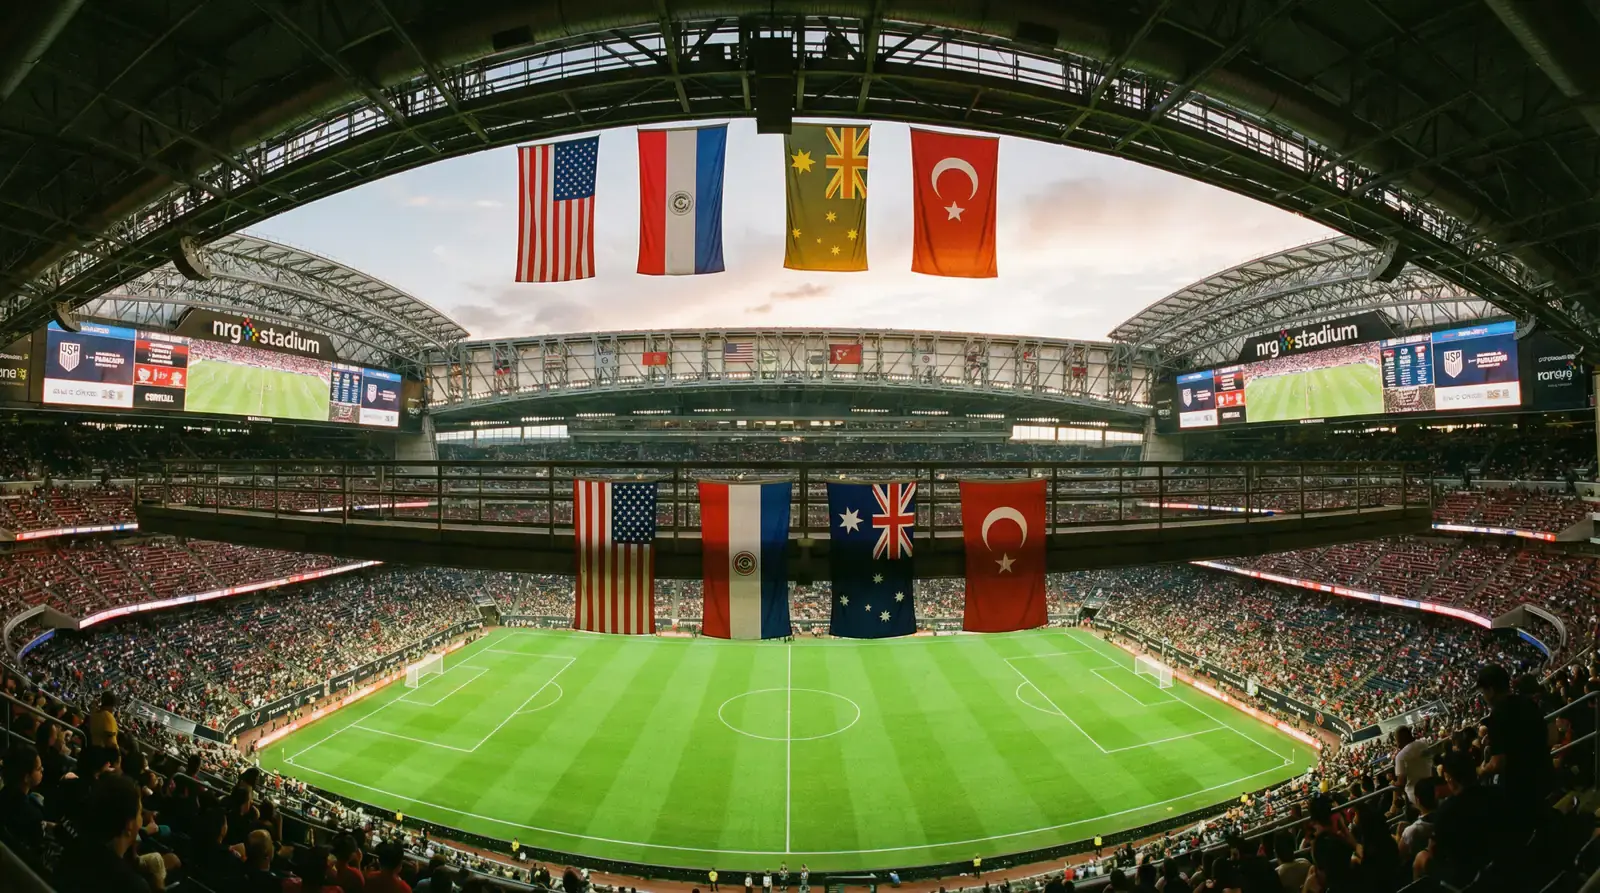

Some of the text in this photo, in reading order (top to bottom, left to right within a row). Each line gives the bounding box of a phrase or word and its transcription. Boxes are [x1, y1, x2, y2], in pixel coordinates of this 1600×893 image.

[213, 320, 320, 354] nrg stadium
[1256, 324, 1358, 358] nrg stadium
